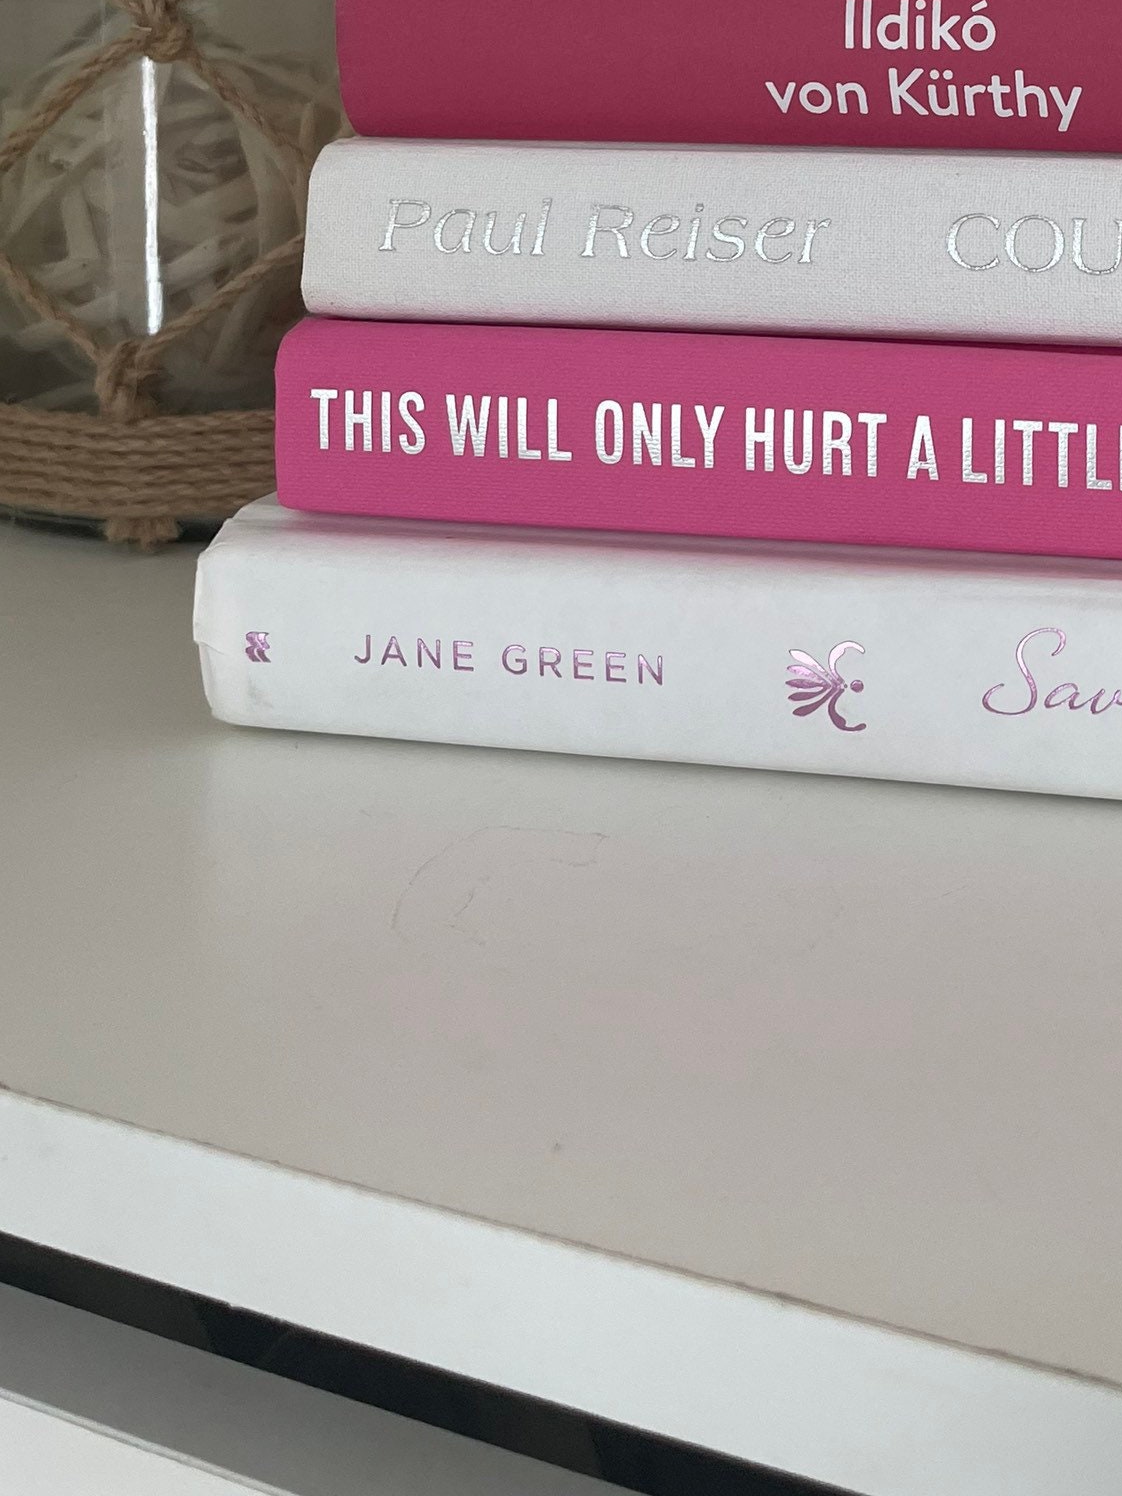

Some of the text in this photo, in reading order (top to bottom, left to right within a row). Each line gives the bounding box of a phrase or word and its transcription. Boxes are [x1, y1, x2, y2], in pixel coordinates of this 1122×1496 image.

[765, 68, 1083, 132] von Kürthy
[378, 198, 832, 265] Paul Reiser
[310, 388, 427, 455] THIS
[444, 393, 574, 463] WILL
[595, 399, 726, 470] ONLY
[744, 406, 888, 477] HURT
[906, 415, 940, 481] A
[354, 634, 665, 687] JANE GREEN
